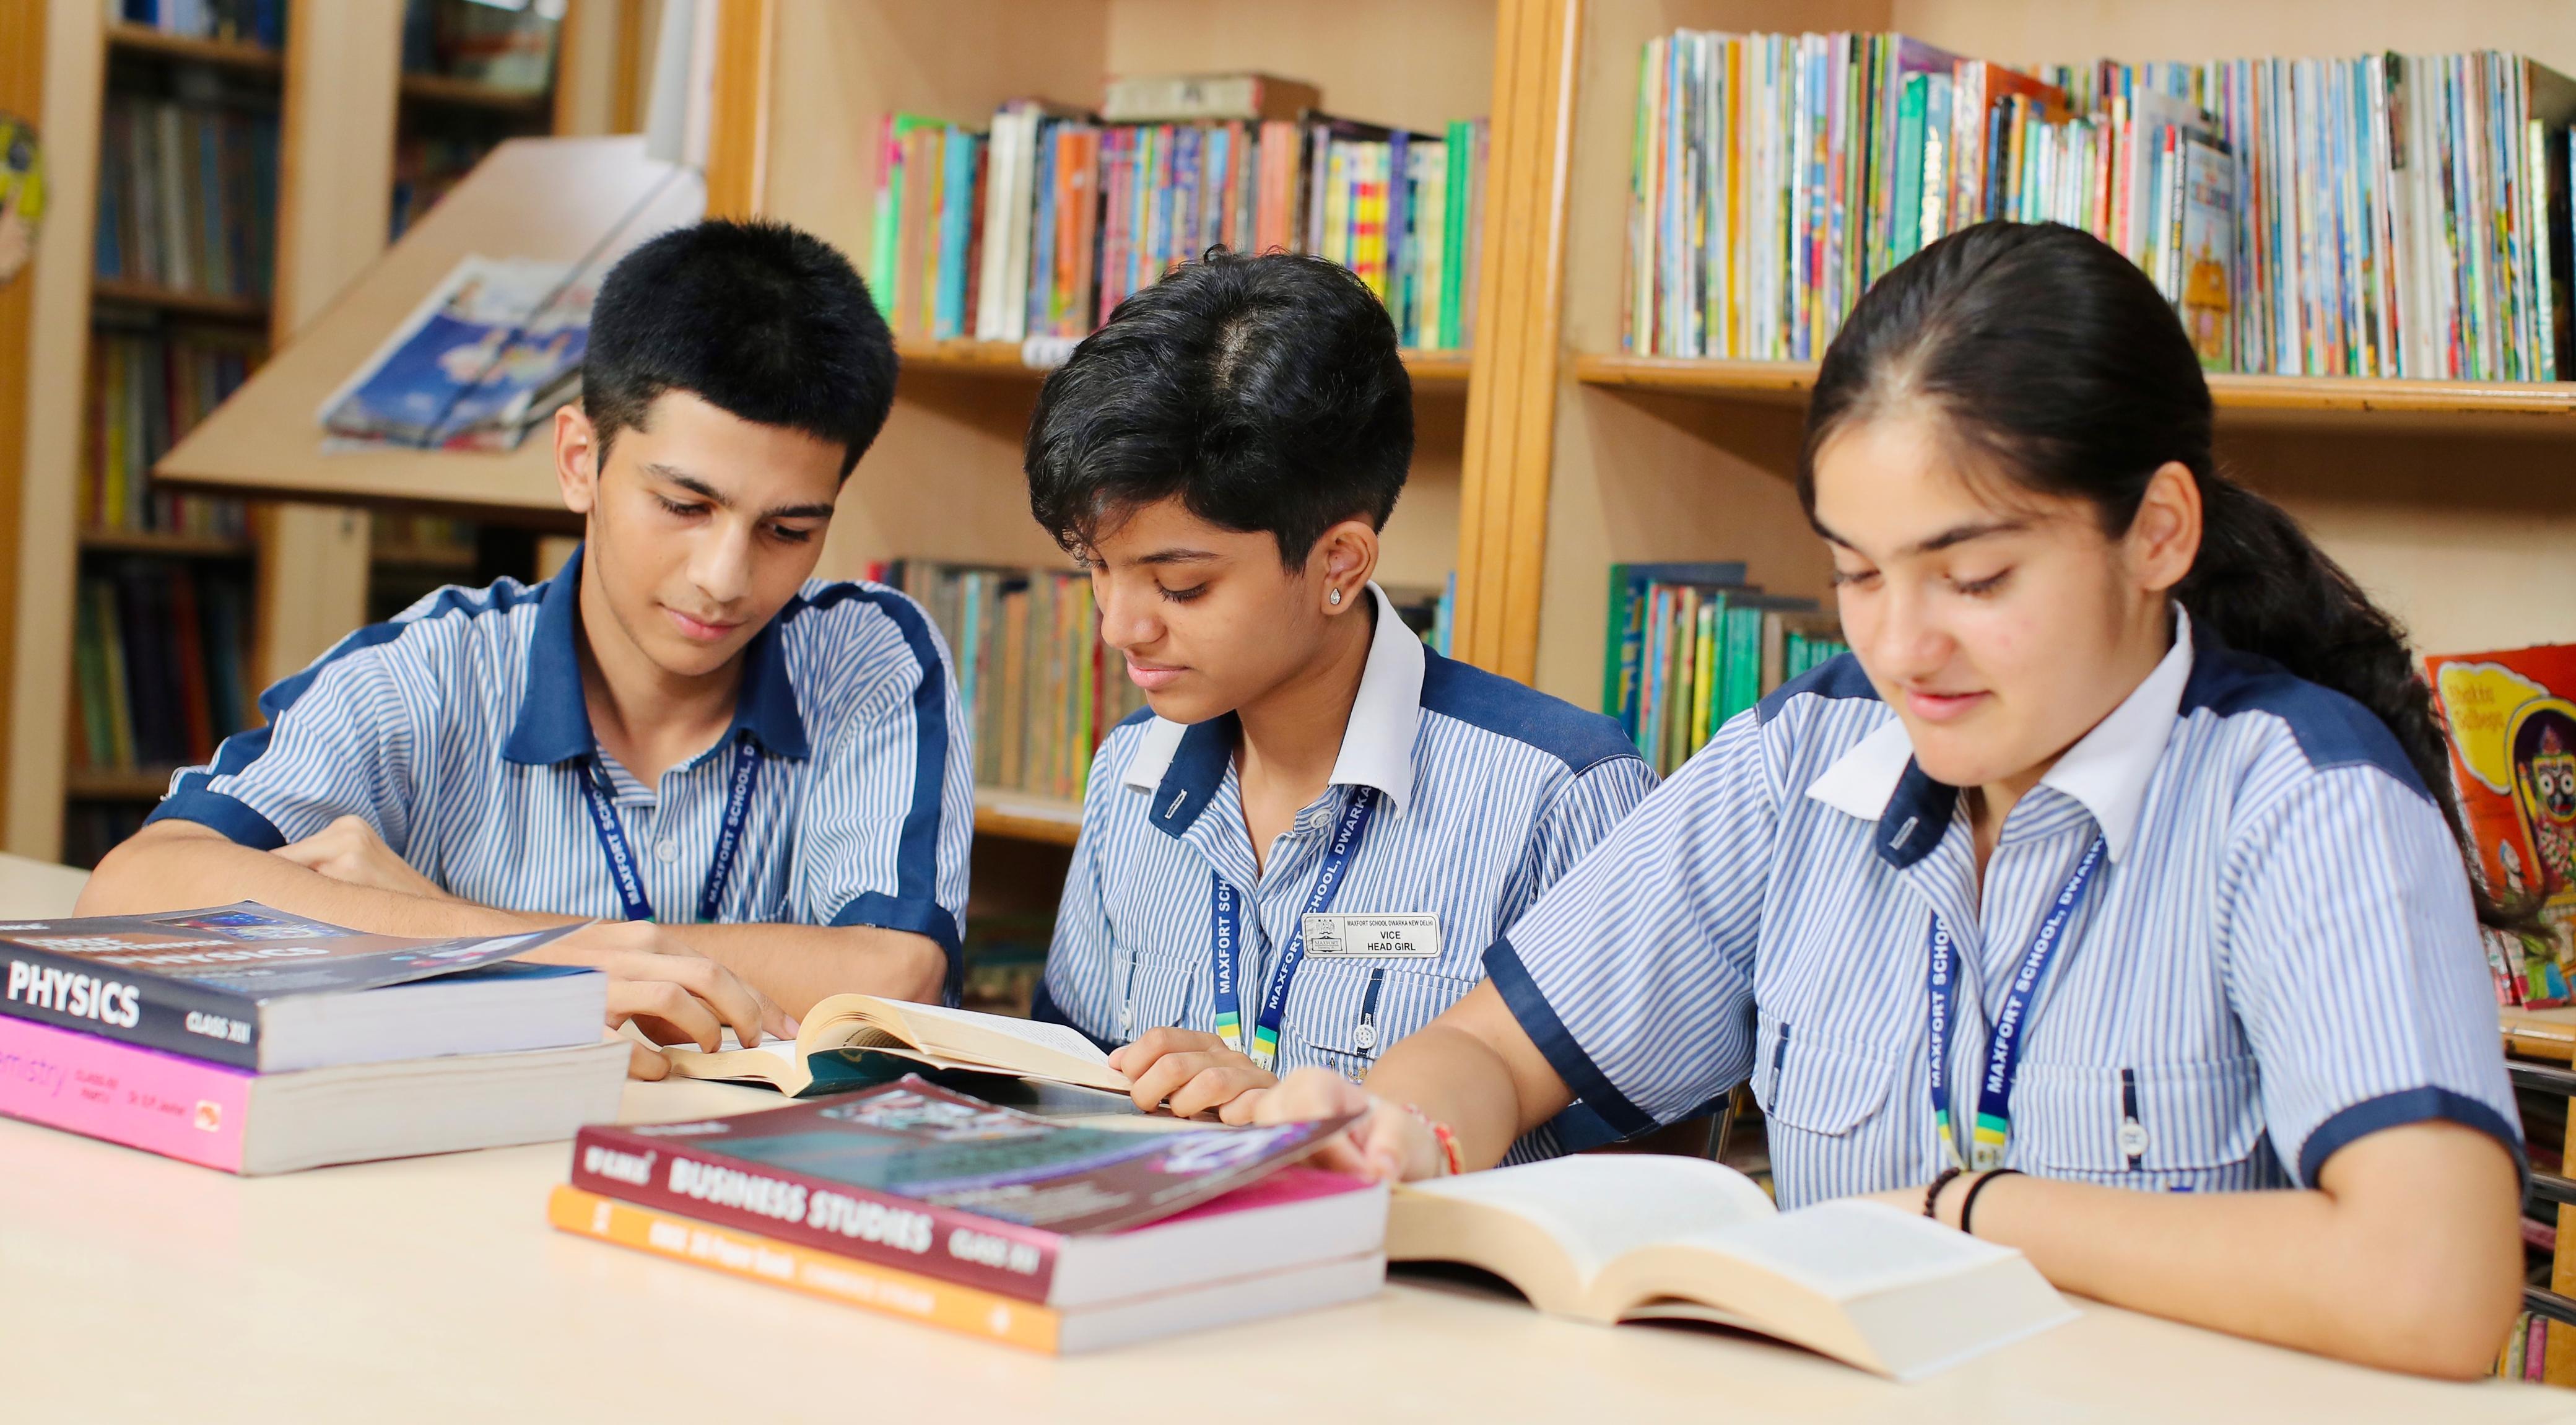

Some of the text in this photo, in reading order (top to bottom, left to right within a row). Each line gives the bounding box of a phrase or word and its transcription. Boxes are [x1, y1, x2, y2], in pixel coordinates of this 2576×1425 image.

[607, 834, 642, 906] MAXFORT
[708, 829, 734, 904] MAXFORT
[1269, 931, 1303, 1010] MAXFORT
[1307, 860, 1342, 913] CHOOL,
[1334, 787, 1372, 855] DWARKA
[1218, 916, 1230, 995] MAXFORT
[1367, 943, 1416, 951] HEAD GIRL
[1380, 931, 1401, 939] VICE
[1987, 996, 2024, 1094] MAXFORT
[2060, 833, 2104, 905] DWARK
[7, 959, 141, 1029] PHYSICS
[186, 1011, 229, 1040] CLASS
[1931, 990, 1945, 1089] MAXFORT
[668, 1156, 807, 1223] BUSINESS
[806, 1189, 934, 1255] STUDIES
